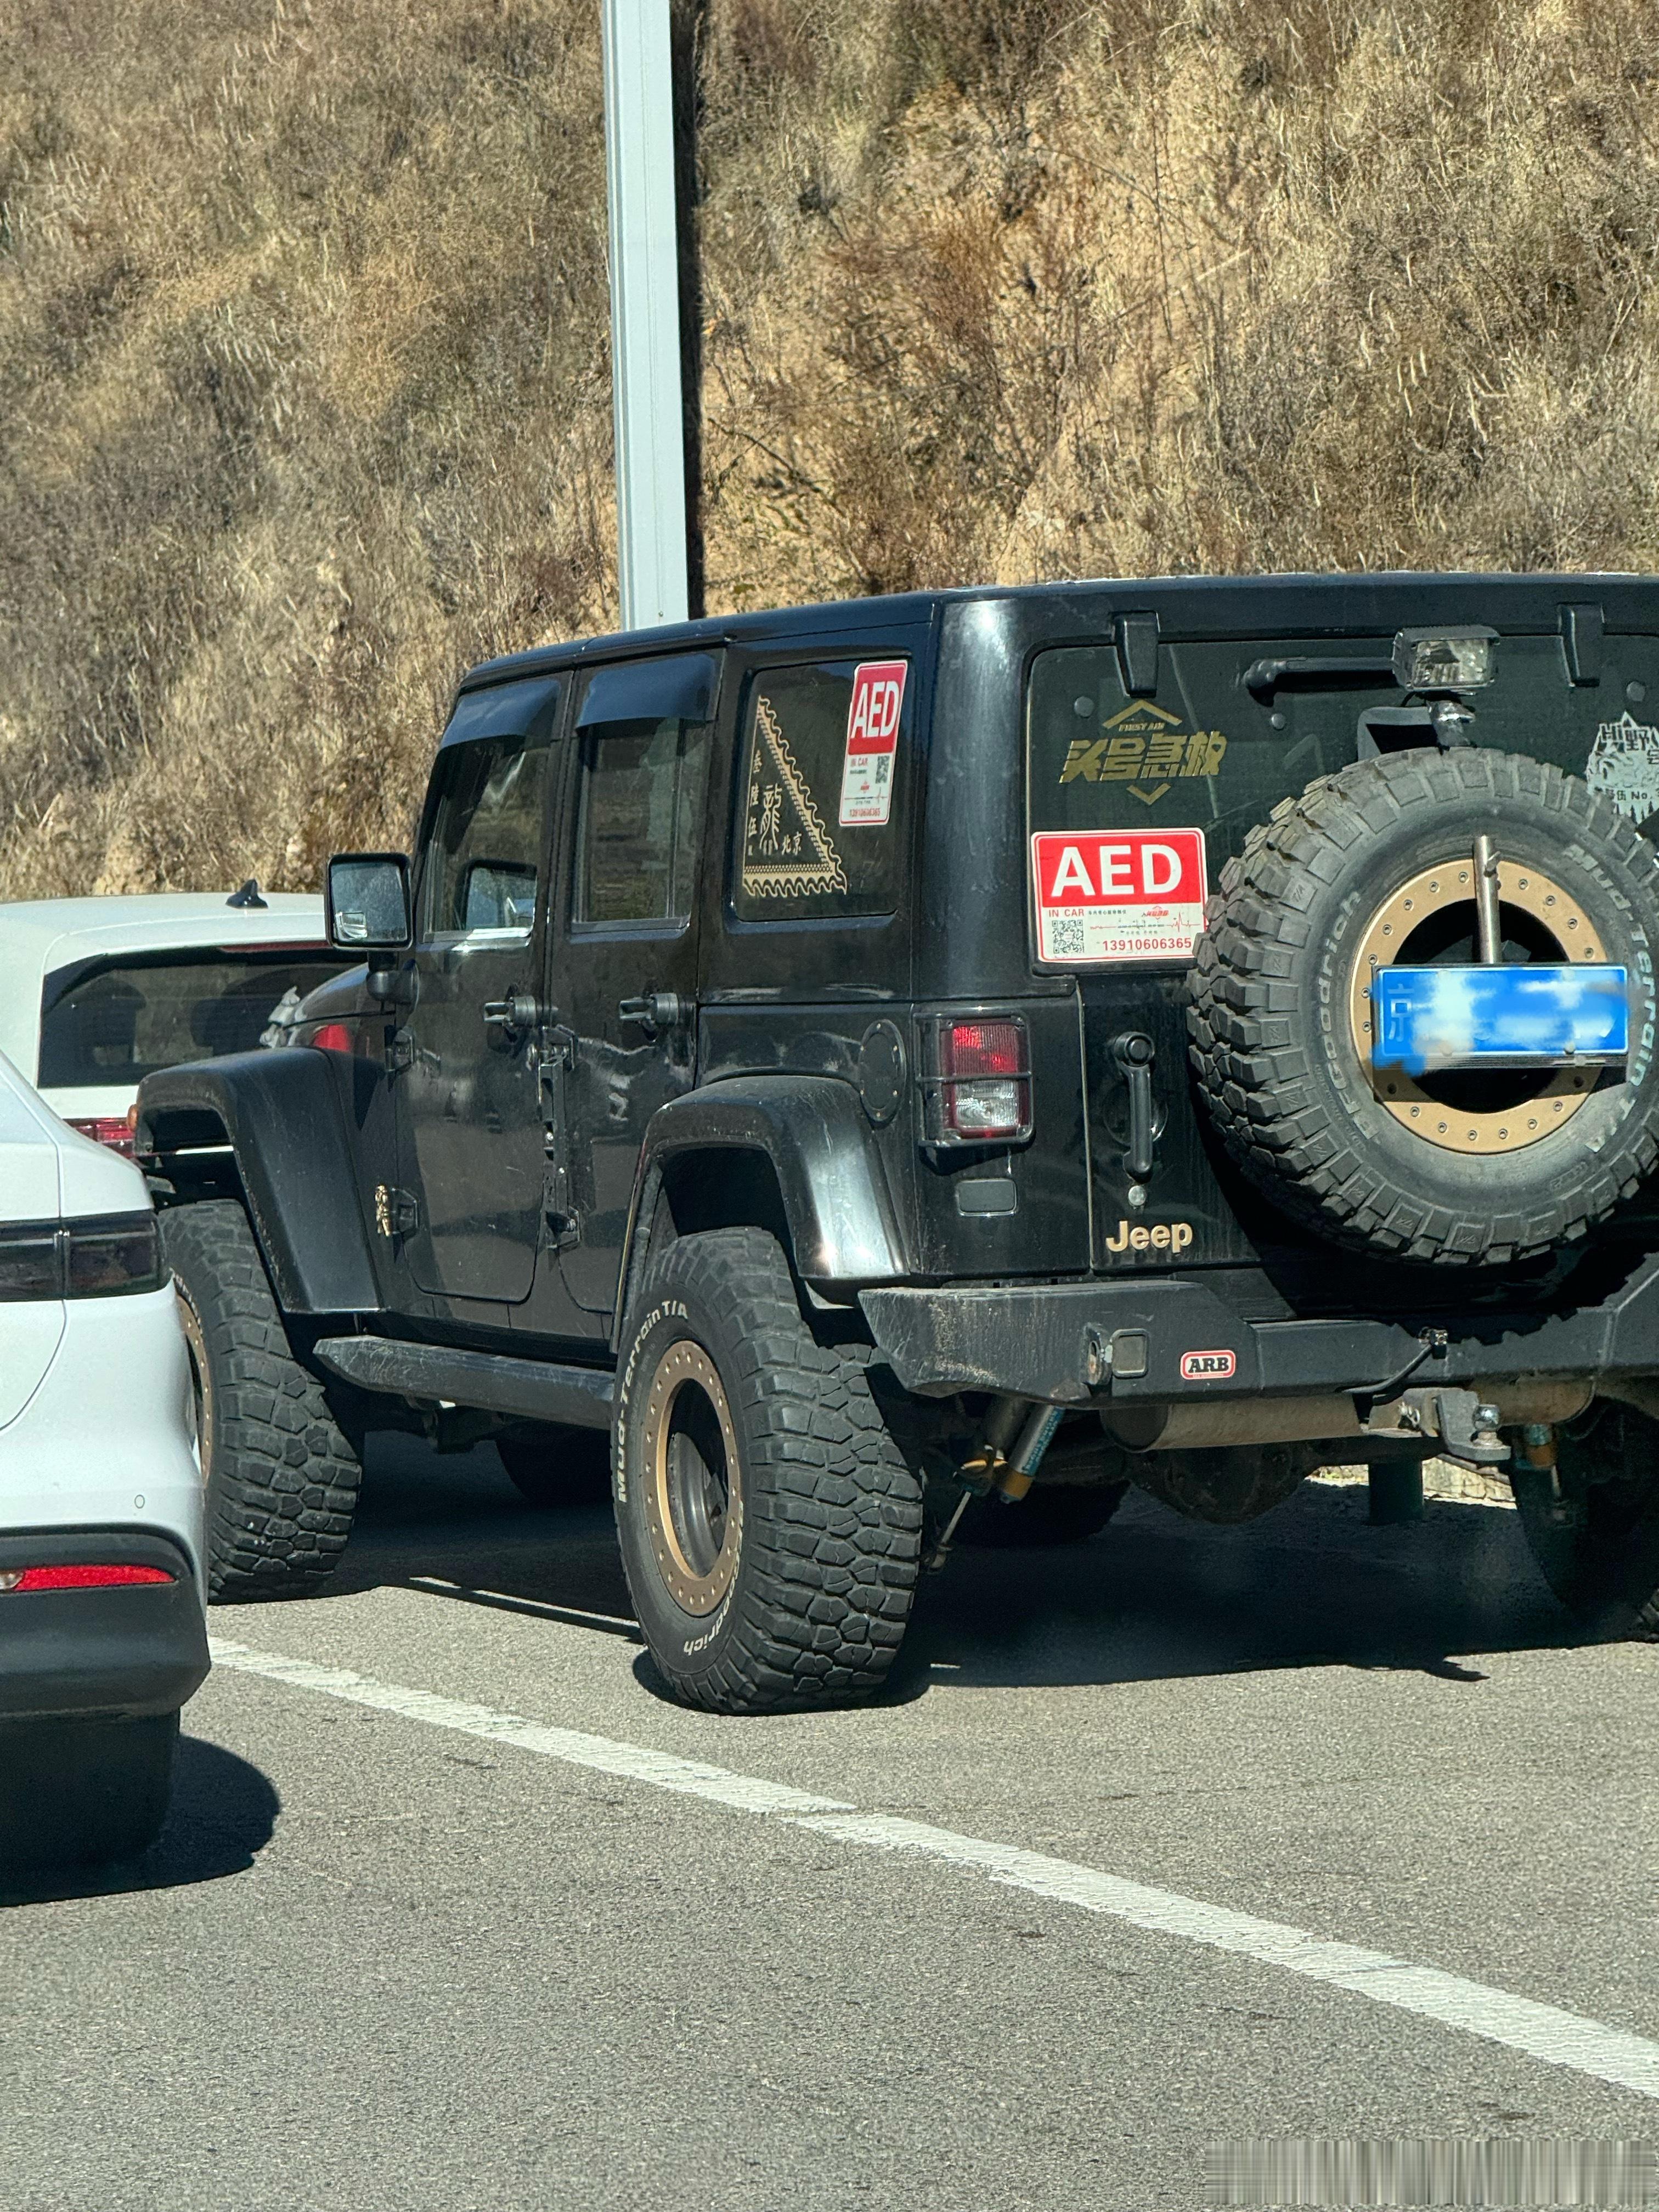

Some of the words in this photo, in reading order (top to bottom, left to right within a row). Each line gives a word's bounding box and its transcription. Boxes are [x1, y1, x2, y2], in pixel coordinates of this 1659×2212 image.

[850, 680, 900, 739] AED
[1051, 843, 1182, 898] AED
[1048, 909, 1059, 917] IN
[1064, 908, 1085, 917] CAR
[1102, 937, 1192, 951] 13910606365
[1105, 1220, 1193, 1253] Jeep
[662, 1300, 689, 1319] T/A
[1188, 1357, 1229, 1373] ARB
[617, 1308, 661, 1503] Mud-Terrain
